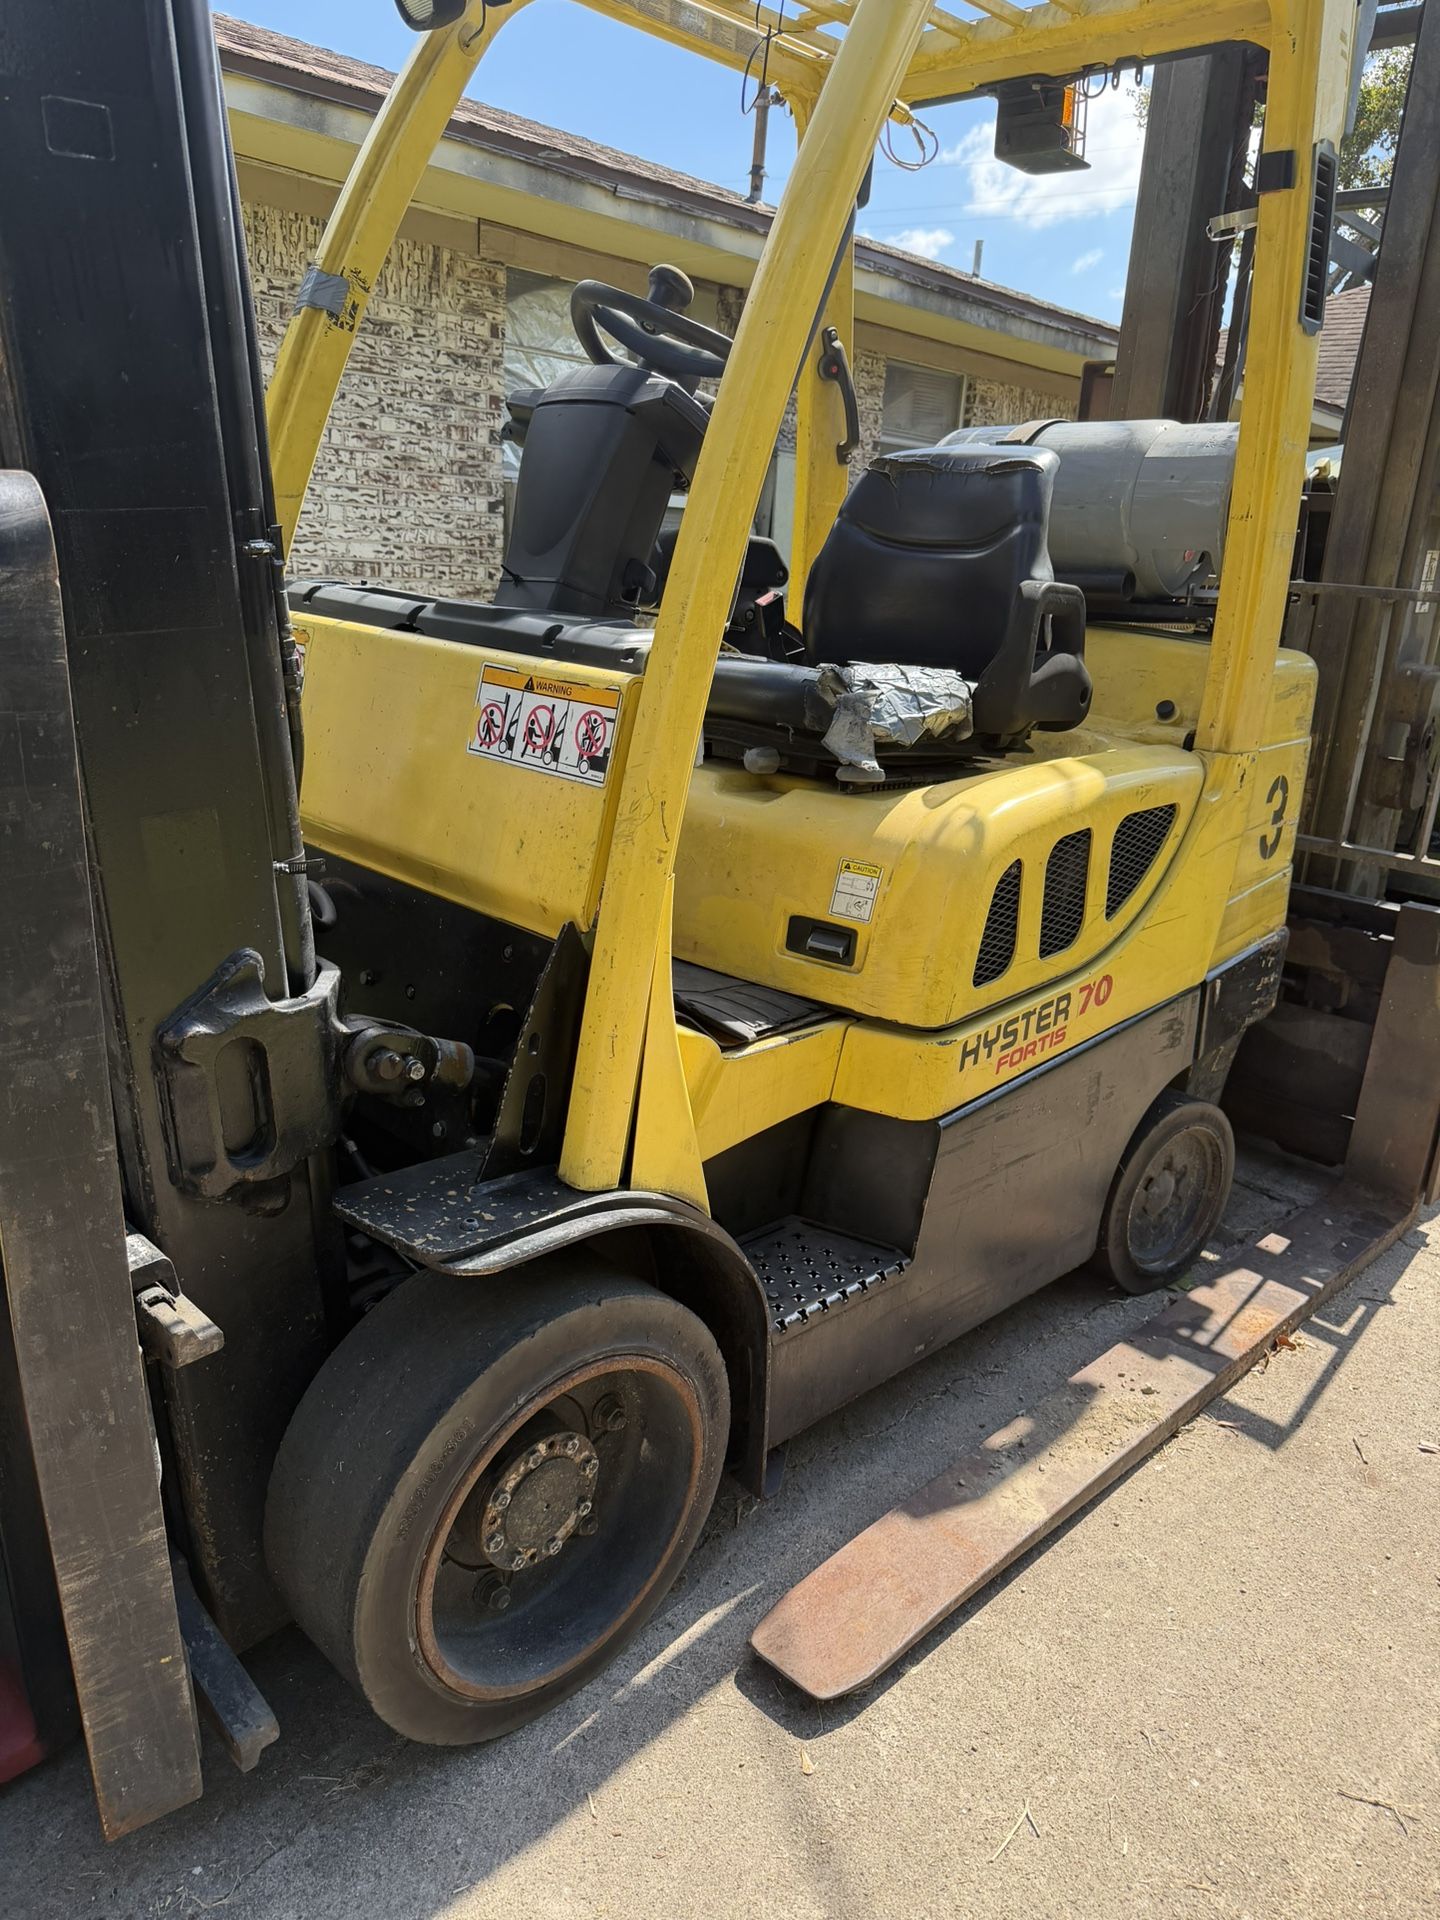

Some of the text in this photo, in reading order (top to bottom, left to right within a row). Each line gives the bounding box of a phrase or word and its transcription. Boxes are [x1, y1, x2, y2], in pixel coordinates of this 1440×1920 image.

[536, 681, 572, 696] WARNING
[1259, 775, 1289, 860] 3
[852, 864, 878, 875] CAUTION
[959, 974, 1114, 1073] HYSTER 70
[995, 1025, 1068, 1075] FORTIS
